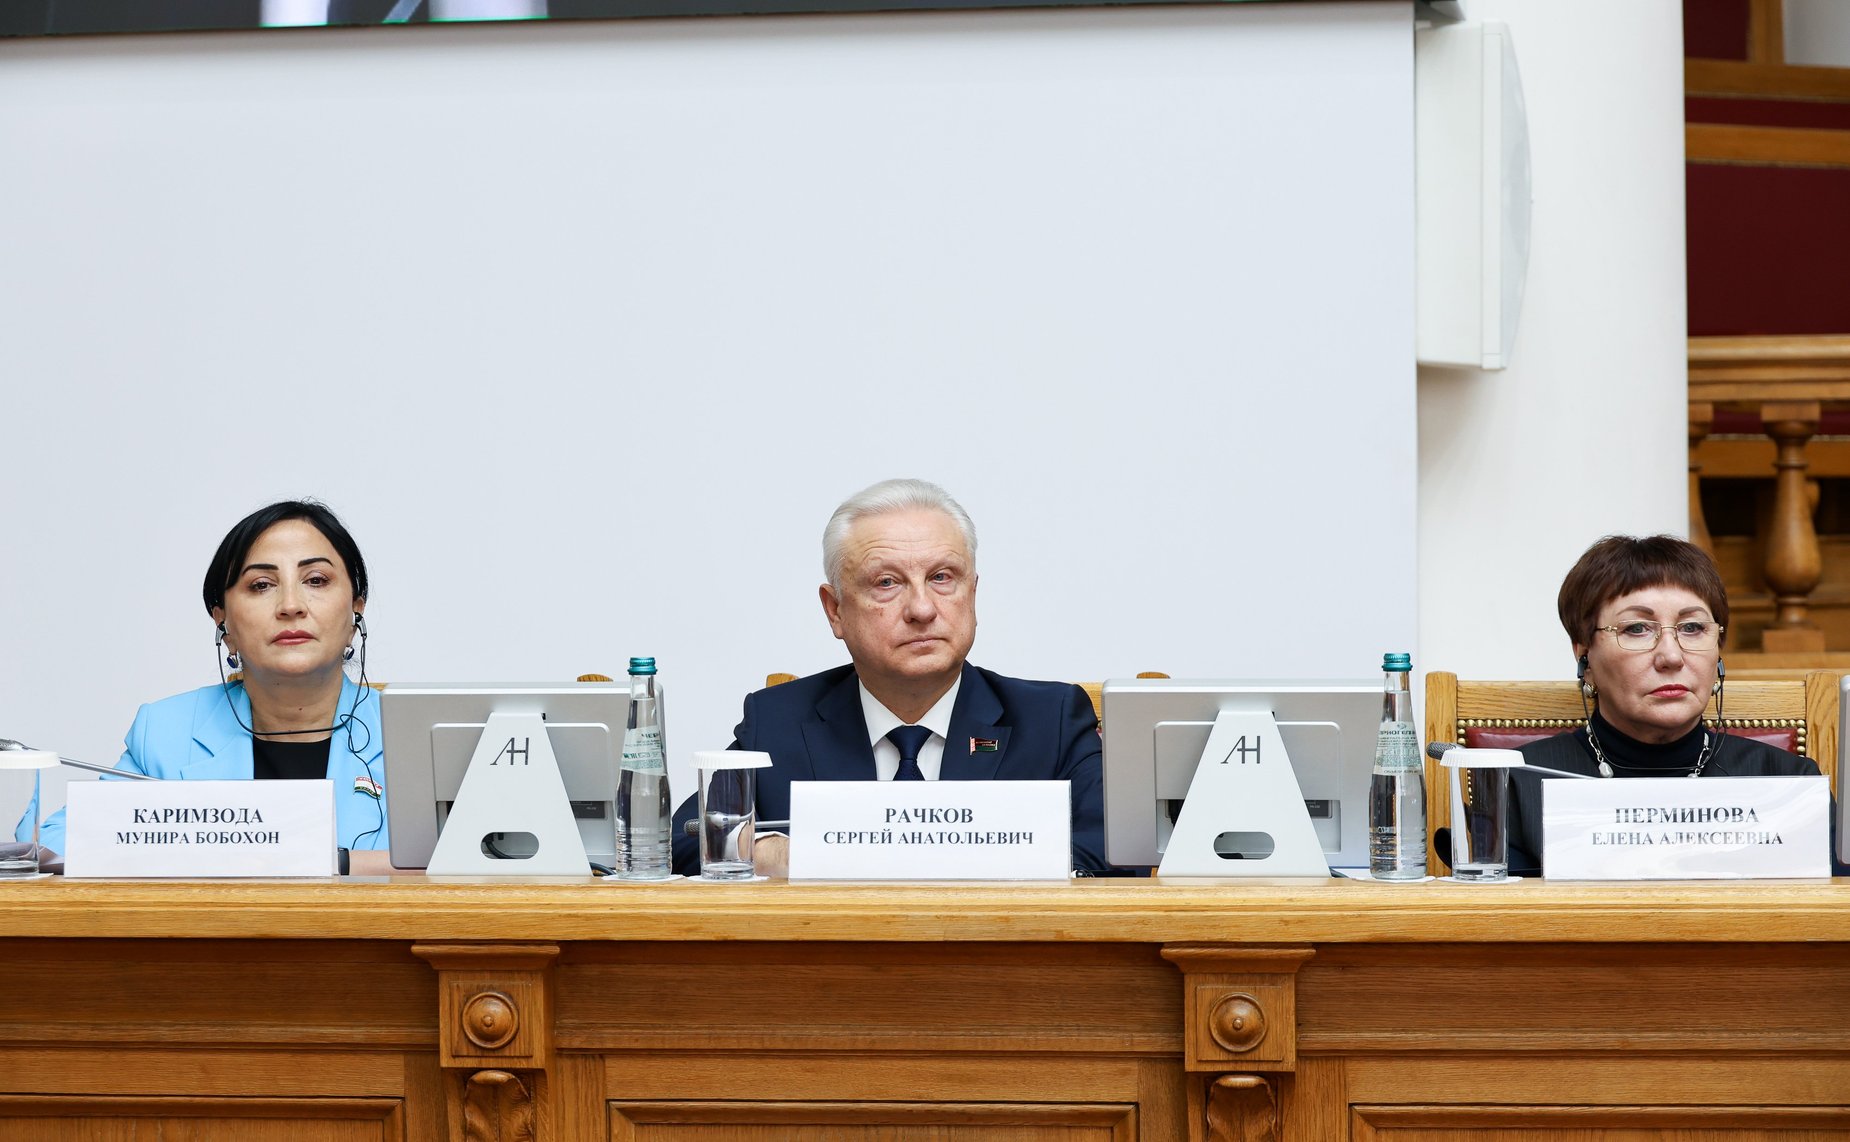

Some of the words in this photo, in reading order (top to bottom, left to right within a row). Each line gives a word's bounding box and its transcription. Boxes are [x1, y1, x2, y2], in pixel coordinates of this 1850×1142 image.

[133, 807, 264, 825] КАРИМЗОДА
[885, 807, 974, 823] РАЧКОВ
[1615, 807, 1760, 824] ПЕРМИНОВА
[116, 831, 191, 845] МУНИРА
[195, 831, 280, 845] БОБОХОН
[823, 828, 893, 845] СЕРГЕЙ
[897, 831, 1034, 845] АНАТОЛЬЕВИЧ
[1592, 831, 1654, 845] ЕЛЕНА
[1659, 831, 1784, 845] АЛЕКСЕЕВНА
